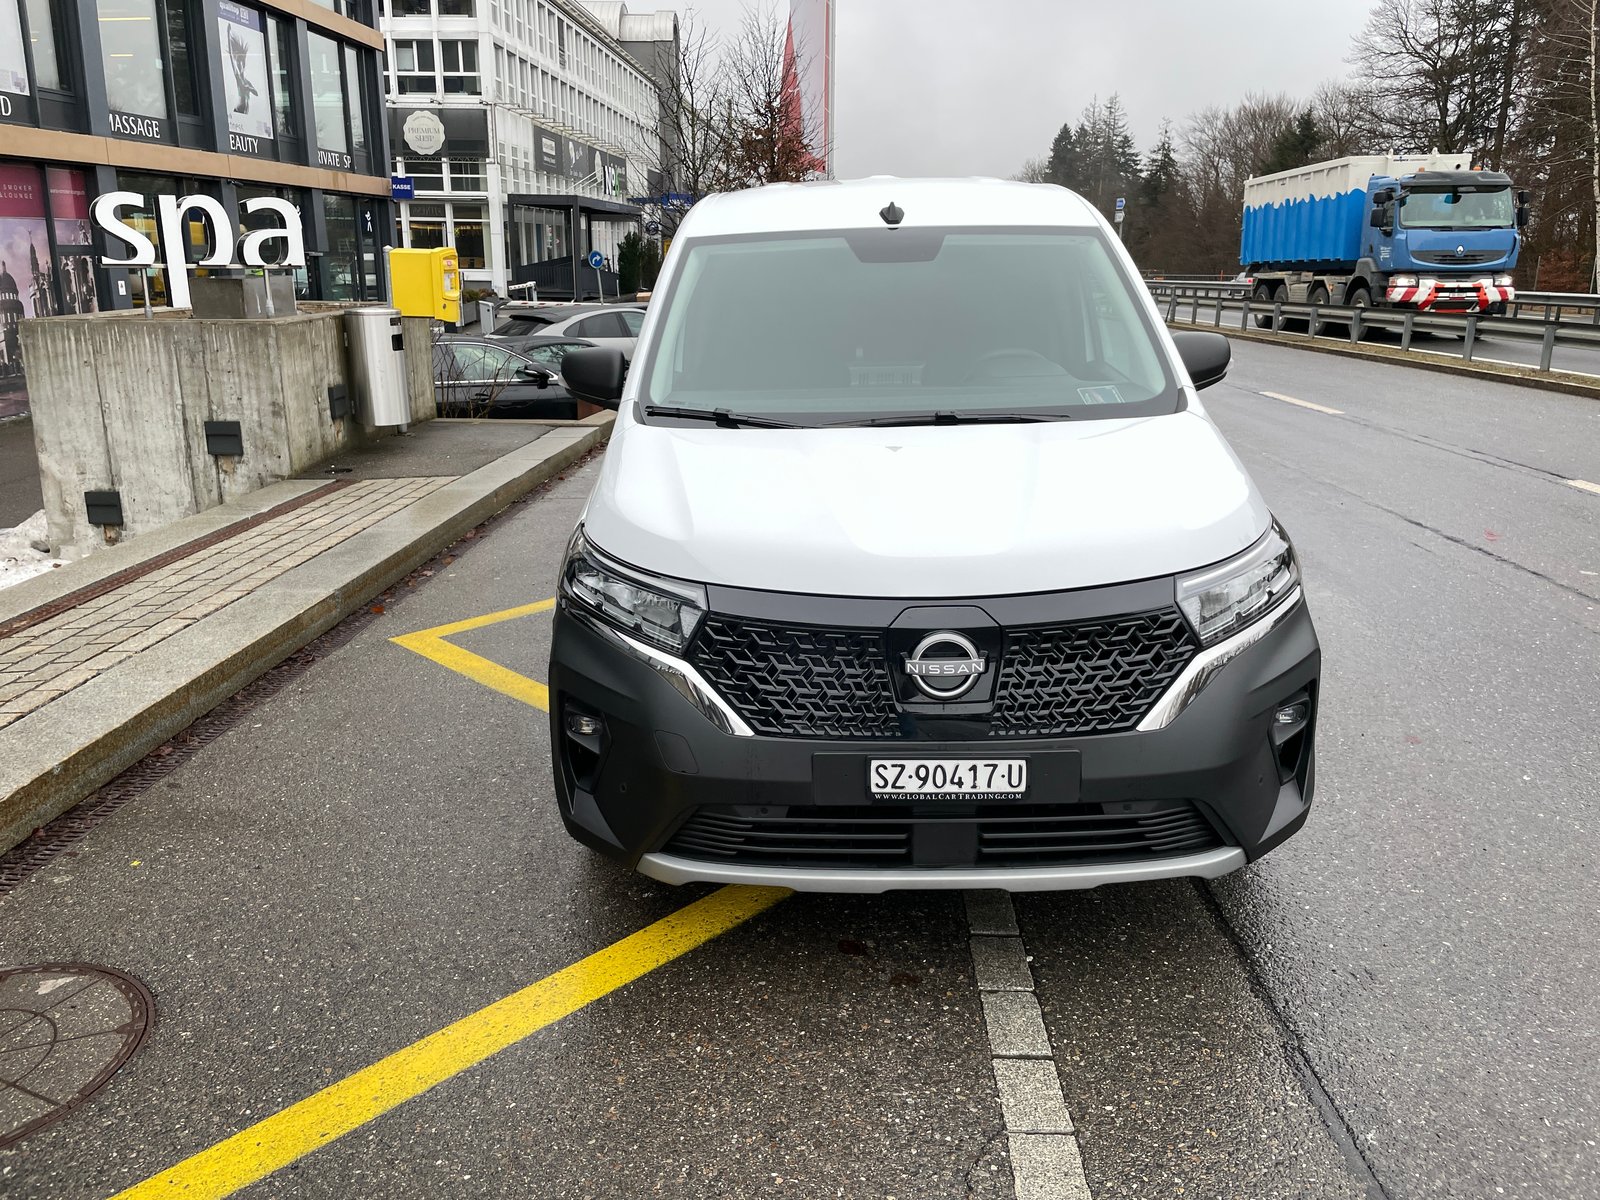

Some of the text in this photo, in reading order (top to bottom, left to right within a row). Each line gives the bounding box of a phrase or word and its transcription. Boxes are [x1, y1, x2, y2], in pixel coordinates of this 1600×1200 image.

[392, 183, 412, 191] KASSE
[89, 190, 306, 309] spa
[906, 662, 983, 675] NISSAN
